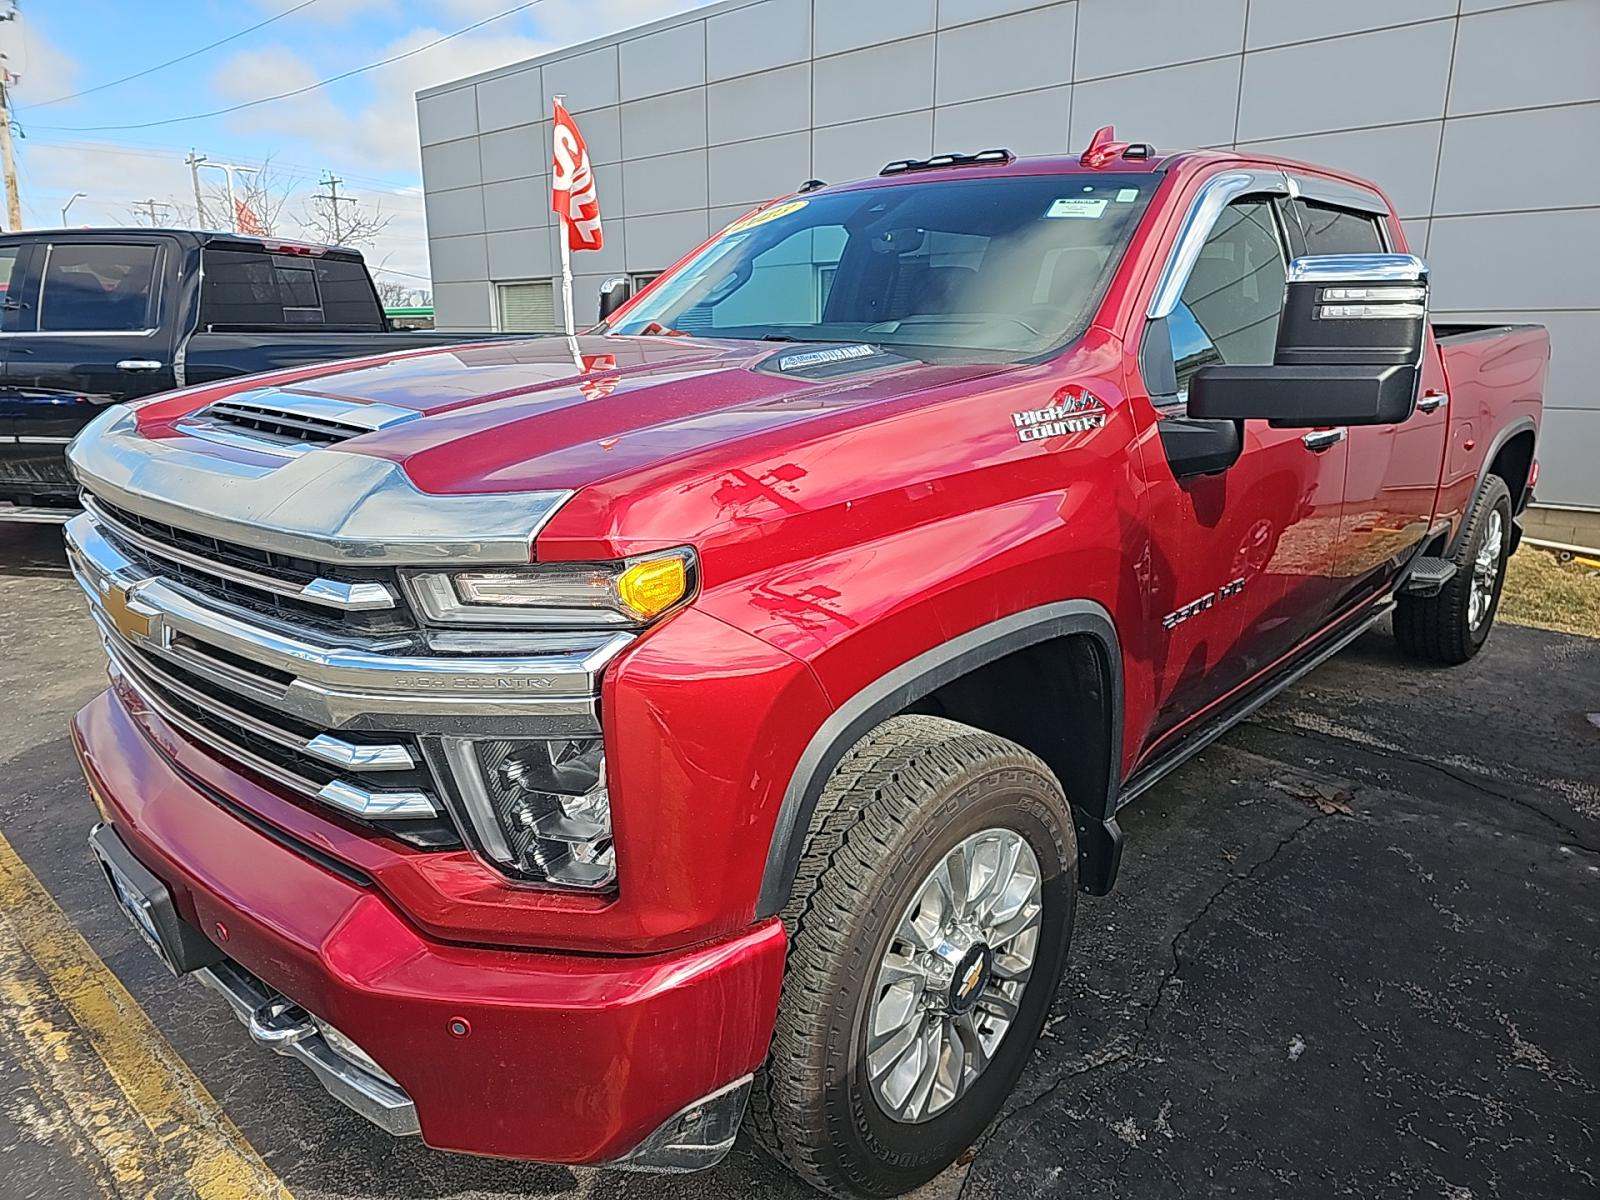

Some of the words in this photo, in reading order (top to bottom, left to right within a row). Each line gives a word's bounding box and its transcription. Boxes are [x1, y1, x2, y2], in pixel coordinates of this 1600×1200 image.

[1011, 406, 1064, 427] HIGH
[1018, 413, 1107, 442] COUNTRY
[1218, 577, 1245, 600] HD
[453, 677, 558, 689] COUNTRY
